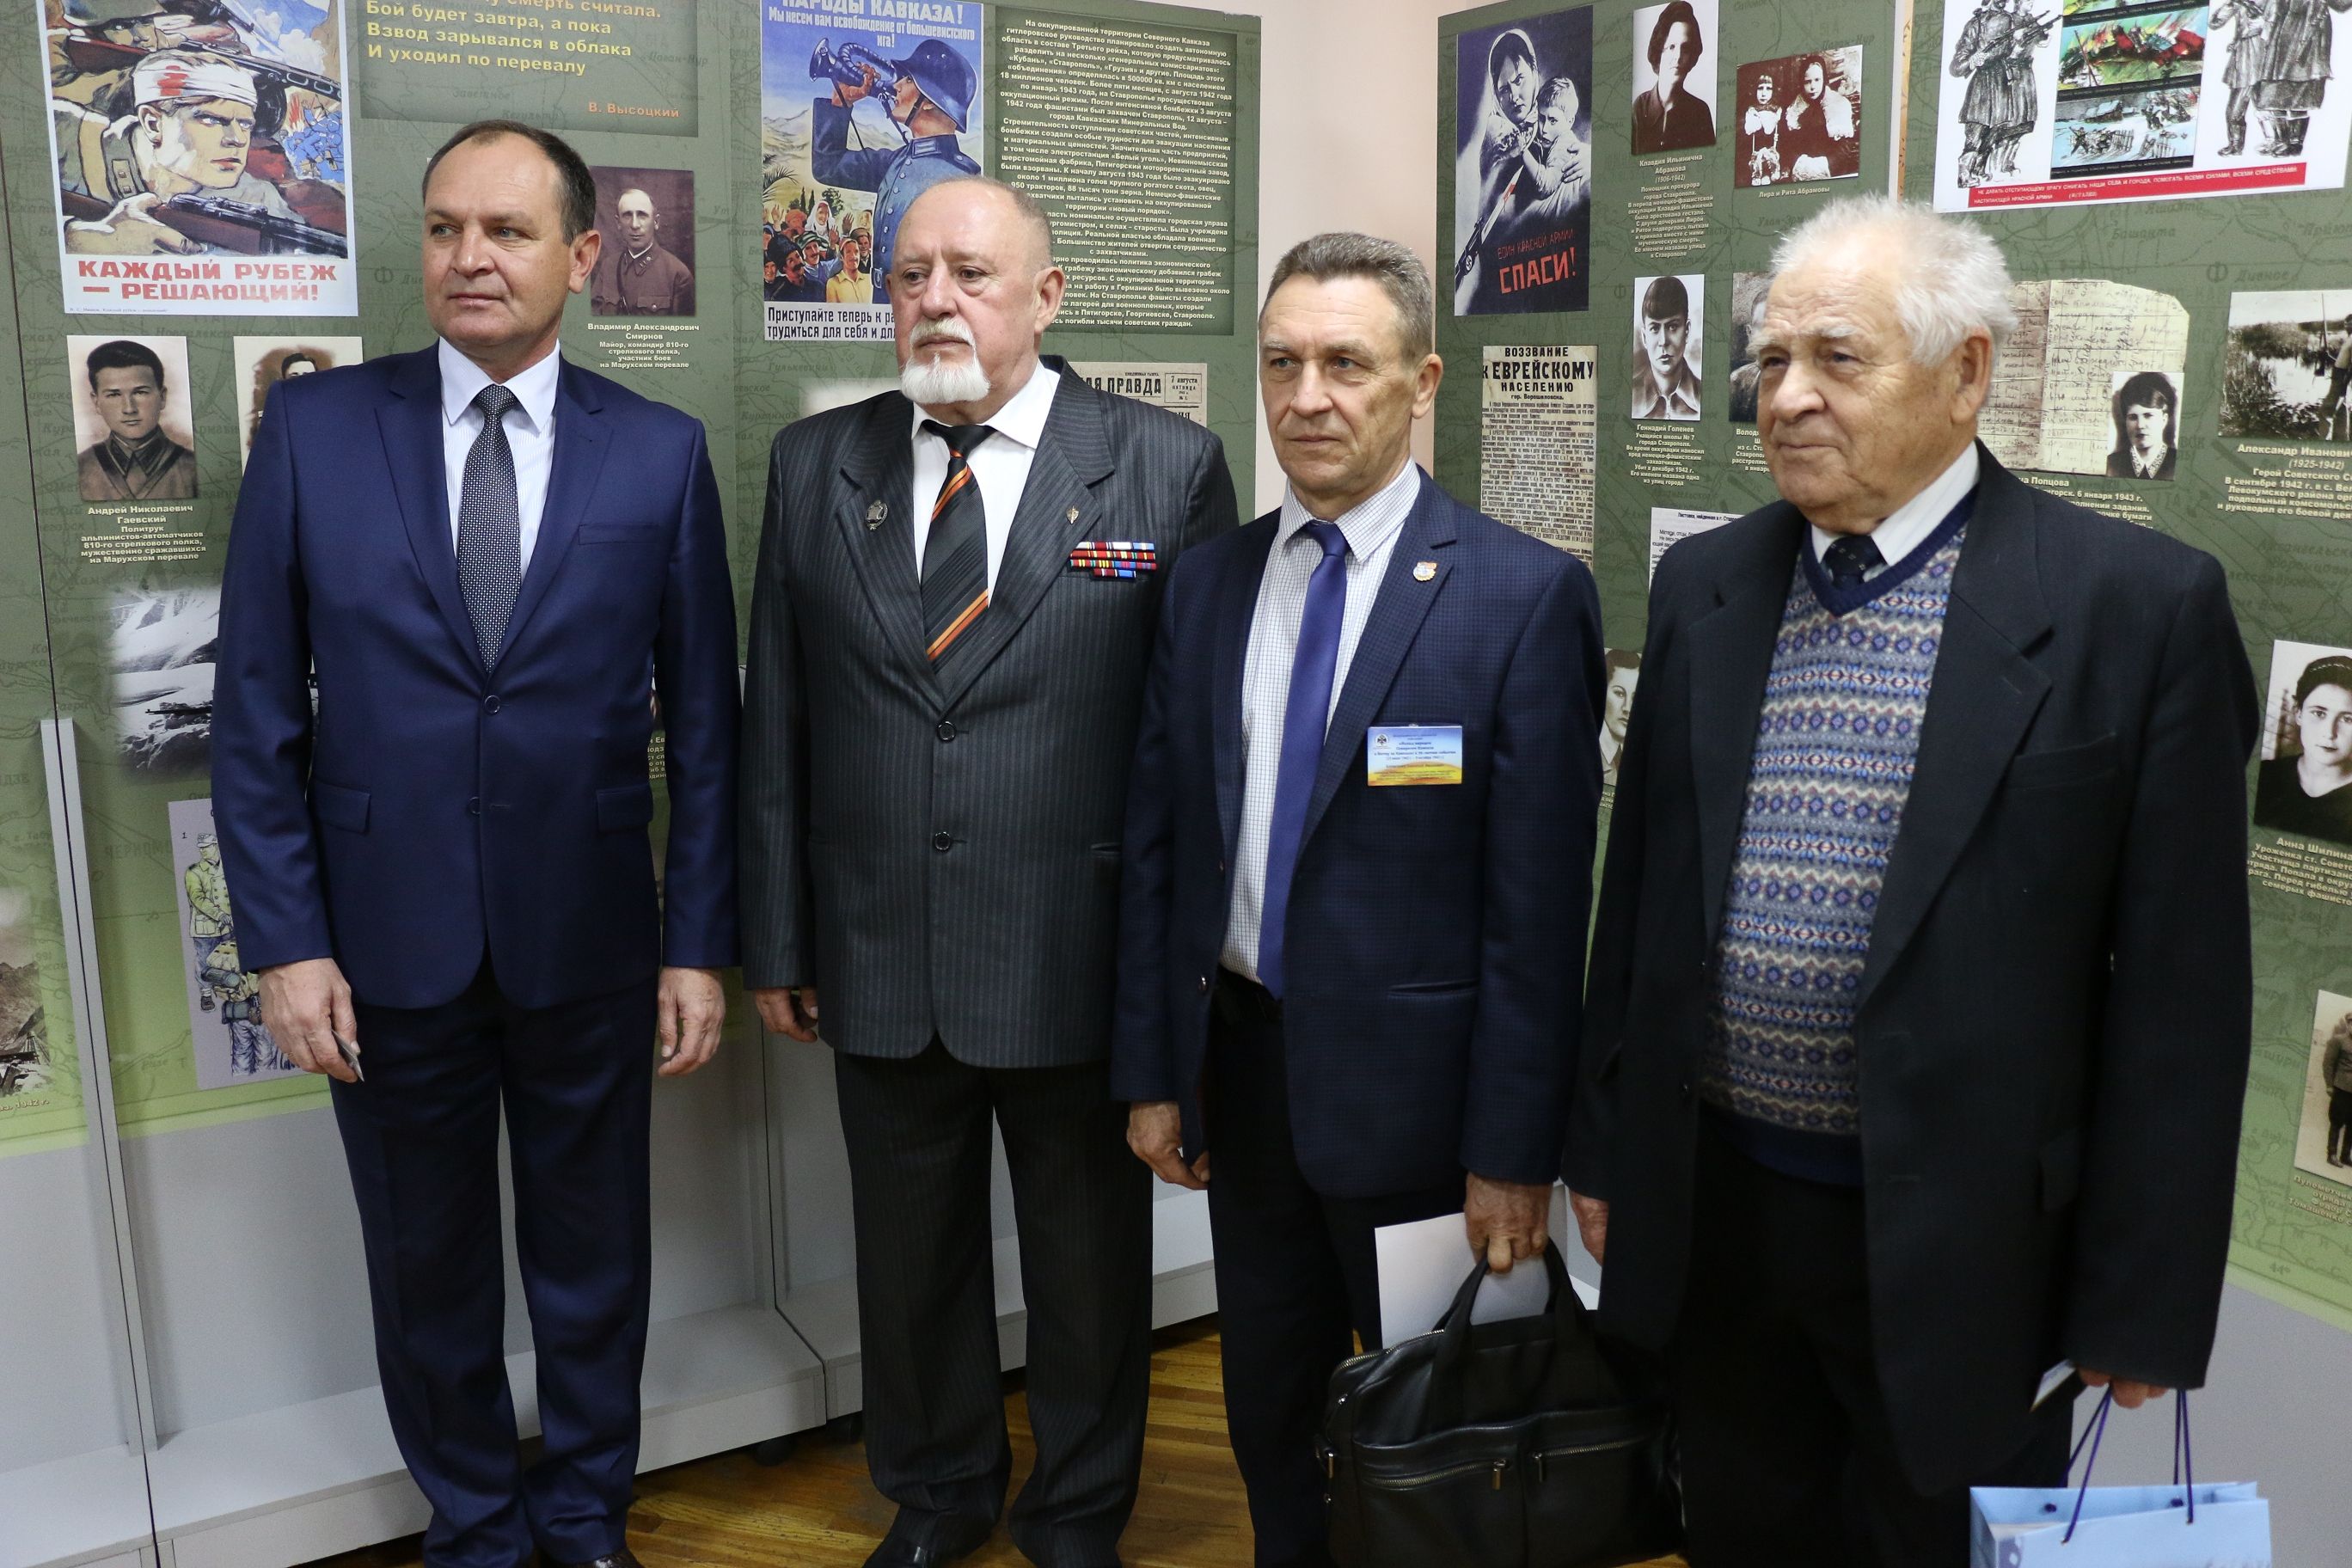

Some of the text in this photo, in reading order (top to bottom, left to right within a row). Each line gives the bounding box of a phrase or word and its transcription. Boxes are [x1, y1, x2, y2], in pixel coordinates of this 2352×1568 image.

[580, 0, 661, 18] считала.
[871, 0, 963, 24] КАВКАЗА!
[366, 1, 611, 34] Бой будет завтра, а пока
[769, 7, 975, 40] Мы несем вам освобождение от большевистского
[367, 22, 631, 57] Взвод зарывался в облака
[1038, 20, 1098, 36] оккупированной
[1101, 28, 1141, 40] территории
[1143, 32, 1179, 45] Северного
[1182, 36, 1210, 46] Кавказа
[877, 34, 894, 47] ига!
[1007, 28, 1227, 58] гитлеровское руководство планировало создать автономную
[1001, 35, 1032, 46] область
[1041, 40, 1069, 49] составе
[1072, 42, 1104, 54] Третьего
[1106, 46, 1129, 57] рейха,
[1132, 50, 1161, 60] которую
[1163, 53, 1230, 67] предусматривалось
[1015, 46, 1054, 58] разделить
[1068, 52, 1106, 62] несколько
[1108, 56, 1158, 69] «генеральных
[368, 45, 586, 77] И уходил по перевалу
[588, 101, 680, 118] В. Высоцкий
[1667, 155, 1702, 163] Ильинична
[1655, 166, 1686, 175] Абрамова
[1065, 203, 1106, 212] территории
[78, 259, 337, 280] КАЖДЫЙ РУБЕЖ
[1499, 247, 1576, 294] СПАСИ!
[122, 282, 318, 302] РЕШАЮЩИЙ!
[768, 307, 833, 323] Приступайте
[838, 311, 872, 324] теперь
[768, 326, 819, 340] трудиться
[823, 327, 841, 339] для
[845, 324, 867, 338] себя
[1505, 347, 1568, 357] ВОЗЗВАНИЕ
[1492, 359, 1594, 379] ЕВРЕЙСКОМУ
[1107, 377, 1161, 395] ПРАВДА
[1501, 383, 1573, 392] НАСЕЛЕНИЮ
[1637, 424, 1666, 432] Геннадий
[2238, 444, 2298, 456] Александр
[2289, 459, 2344, 470] (1925-1942)
[2253, 468, 2340, 481] Герой Советского
[2031, 477, 2069, 487] Попцова
[2234, 479, 2276, 488] сентябре
[2281, 481, 2302, 489] 1942
[2085, 492, 2112, 500] января
[2115, 493, 2134, 501] 1943
[88, 506, 127, 516] Андрей
[81, 531, 204, 542] альпинистов-автоматчиков
[115, 540, 170, 548] стрелкового
[81, 546, 206, 557] мужественно сражавшихся
[104, 554, 155, 564] Марухском
[2276, 837, 2304, 850] Анна
